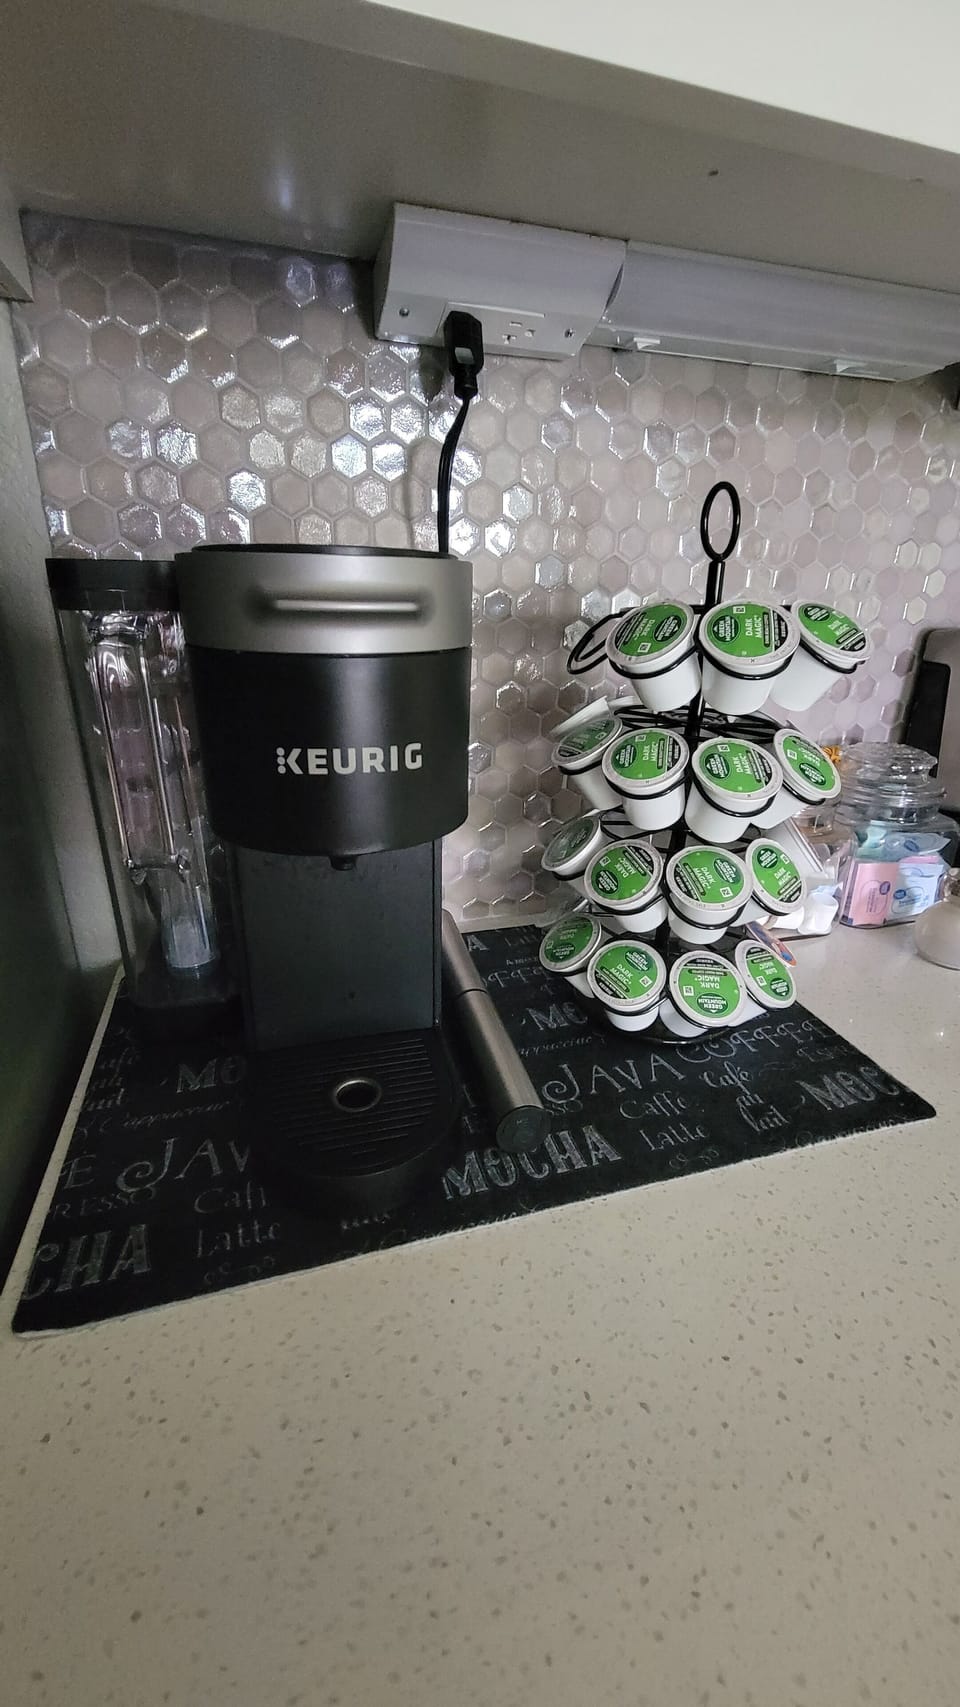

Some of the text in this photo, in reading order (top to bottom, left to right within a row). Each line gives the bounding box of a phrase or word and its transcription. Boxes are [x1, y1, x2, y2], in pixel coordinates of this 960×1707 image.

[277, 743, 423, 775] KEURIG
[541, 1053, 686, 1104] JAVA
[441, 1125, 622, 1200] MOCHA
